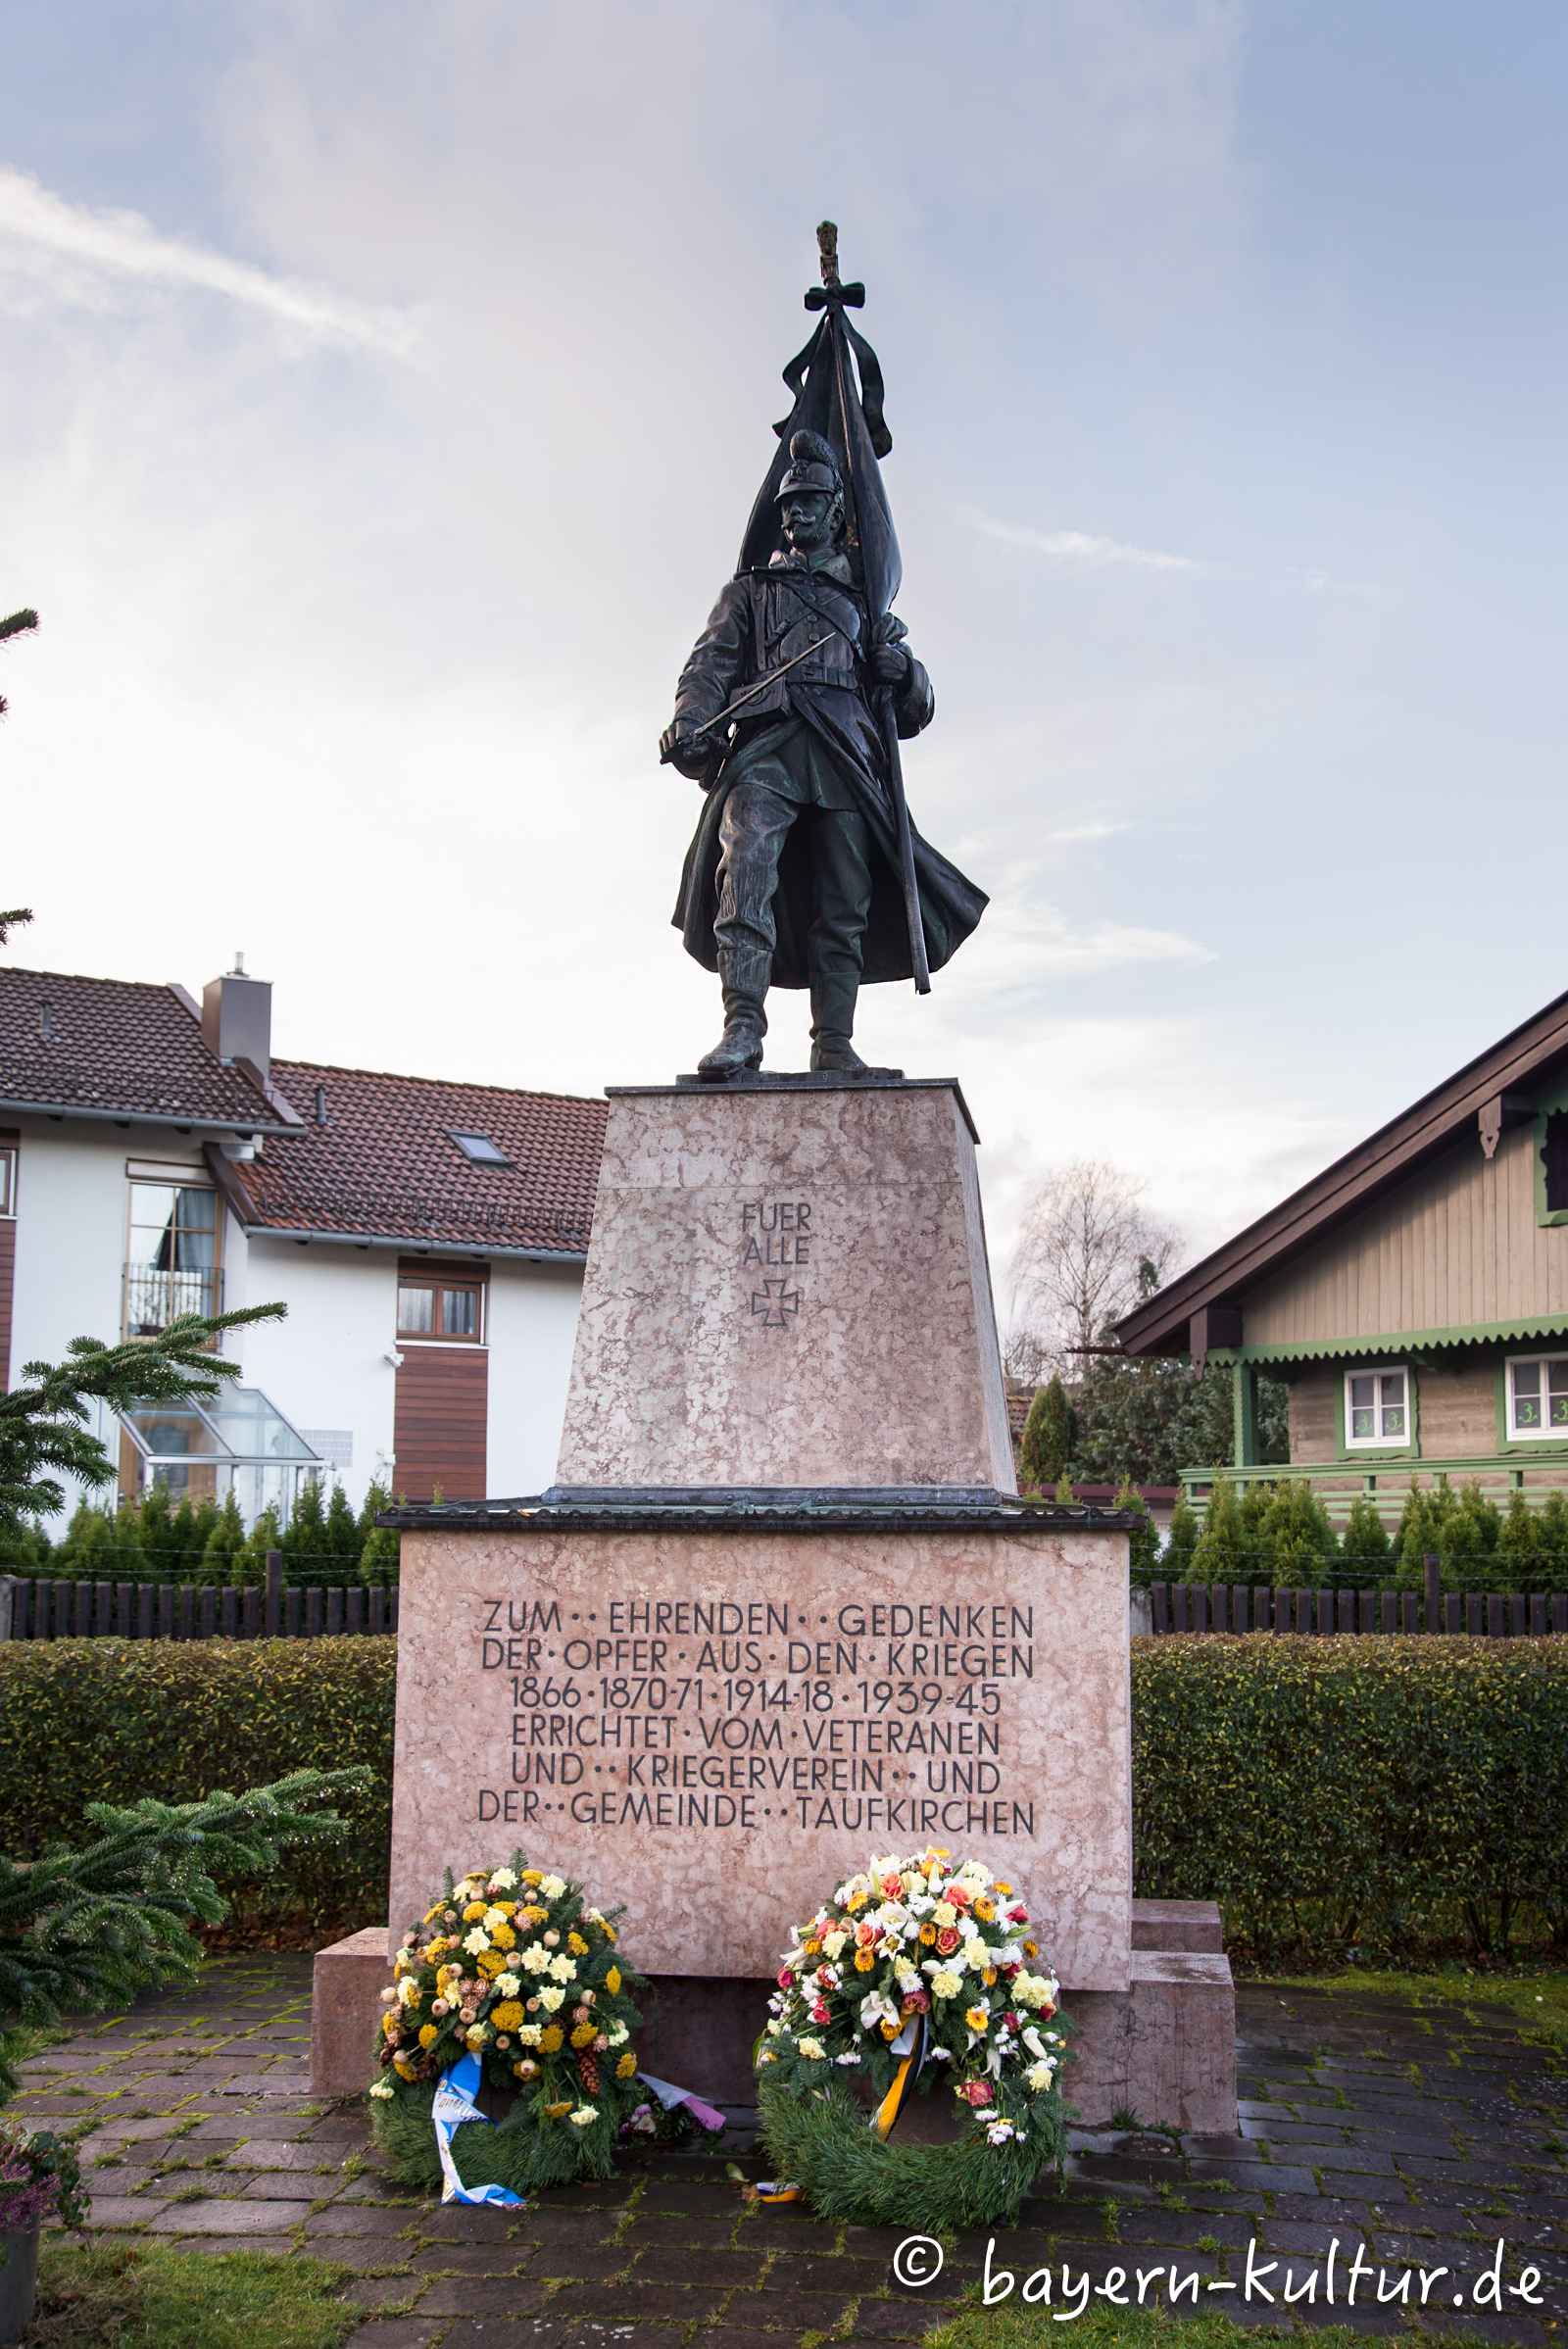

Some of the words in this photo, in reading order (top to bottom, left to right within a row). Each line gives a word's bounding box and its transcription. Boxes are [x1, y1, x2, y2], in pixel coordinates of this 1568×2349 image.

[742, 1202, 811, 1232] FUER
[743, 1235, 810, 1266] ALLE
[483, 1600, 563, 1633] ZUM
[610, 1601, 788, 1636] EHRENDEN
[837, 1603, 1033, 1639] GEDENKEN
[482, 1638, 542, 1671] DER
[564, 1639, 667, 1672] OPFER
[696, 1640, 761, 1673] AUS
[788, 1641, 858, 1675] DEN
[888, 1642, 1033, 1679] KRIEGEN
[510, 1675, 582, 1708] 1866
[599, 1677, 703, 1710] 1870-71
[722, 1679, 834, 1713] 1914-18
[857, 1681, 1001, 1716] 1939-45
[512, 1713, 677, 1749] ERRICHTET
[699, 1716, 783, 1750] VOM
[802, 1719, 1000, 1755] VETERANEN
[512, 1751, 584, 1785] UND
[628, 1754, 883, 1791] KRIEGERVEREIN
[927, 1760, 1001, 1794] UND
[478, 1788, 539, 1823] DER
[570, 1791, 756, 1828] GEMEINDE
[796, 1796, 1034, 1835] TAUFKIRCHEN
